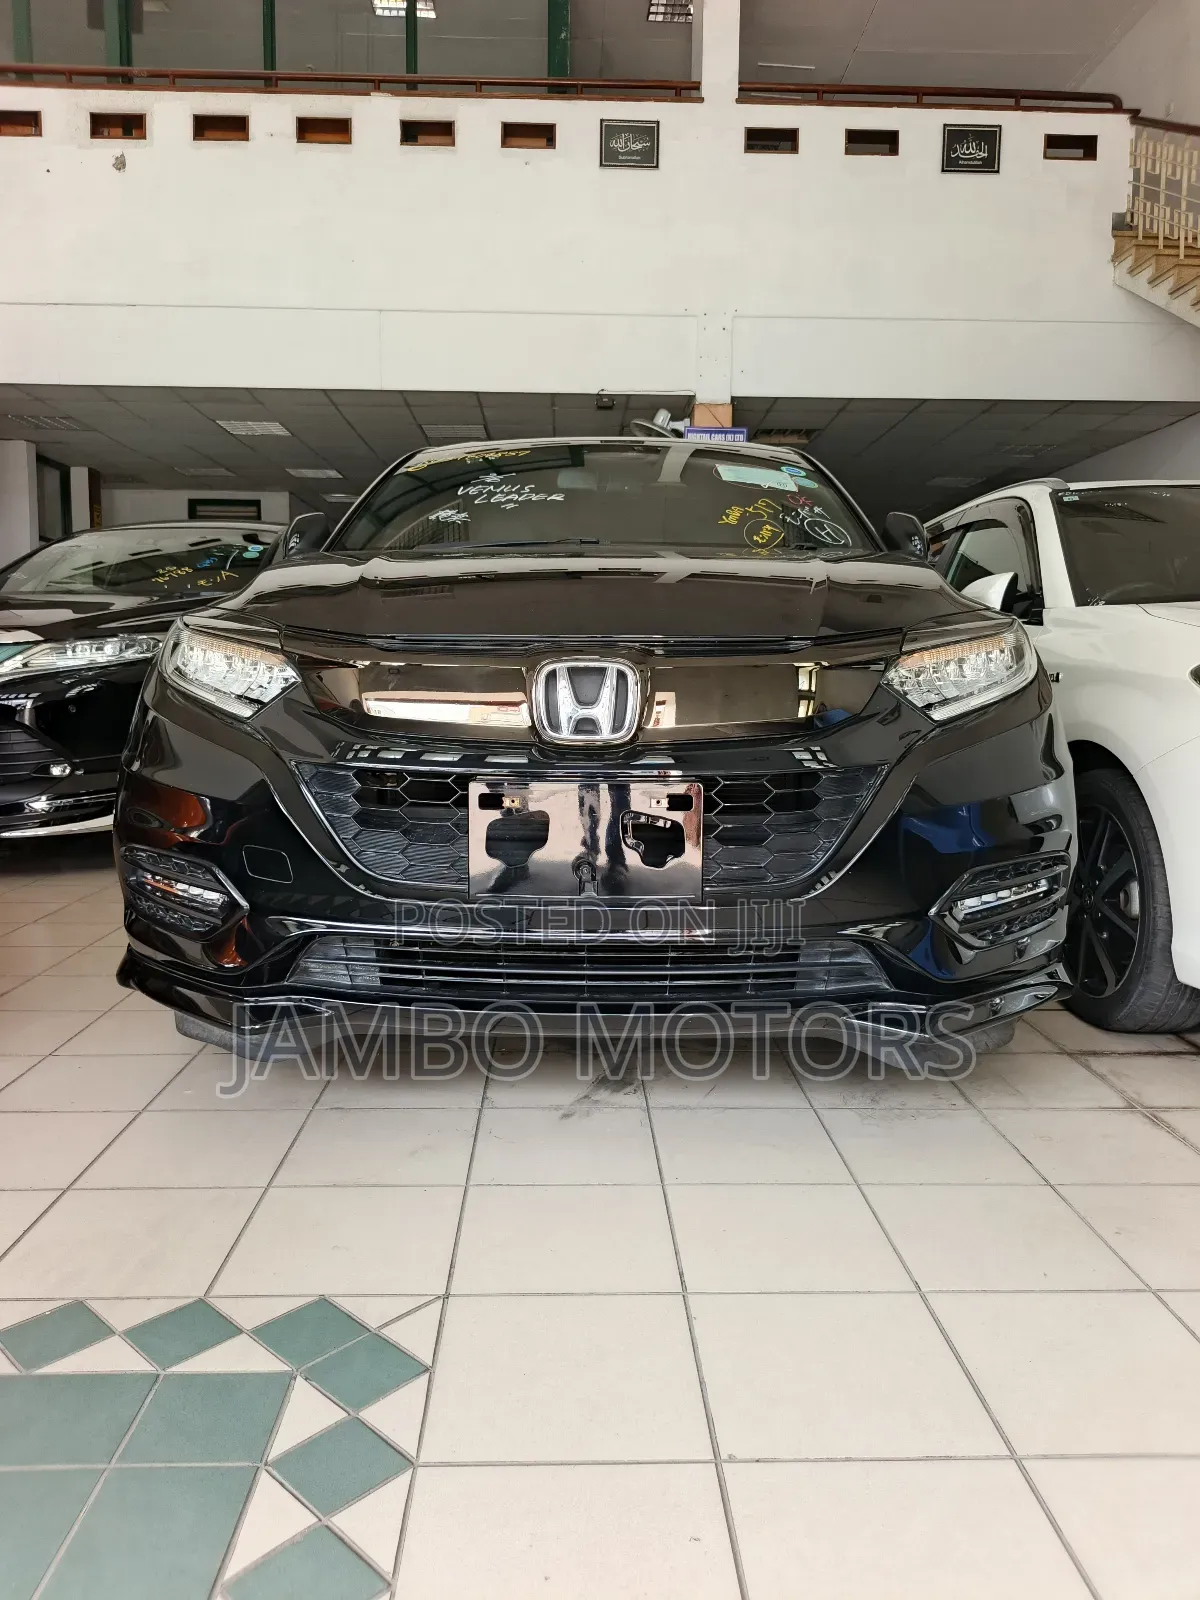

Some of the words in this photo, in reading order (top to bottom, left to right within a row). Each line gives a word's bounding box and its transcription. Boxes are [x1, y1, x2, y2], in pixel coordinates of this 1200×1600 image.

[710, 433, 725, 441] CARS
[734, 434, 744, 442] LTD
[474, 492, 566, 504] LEADER
